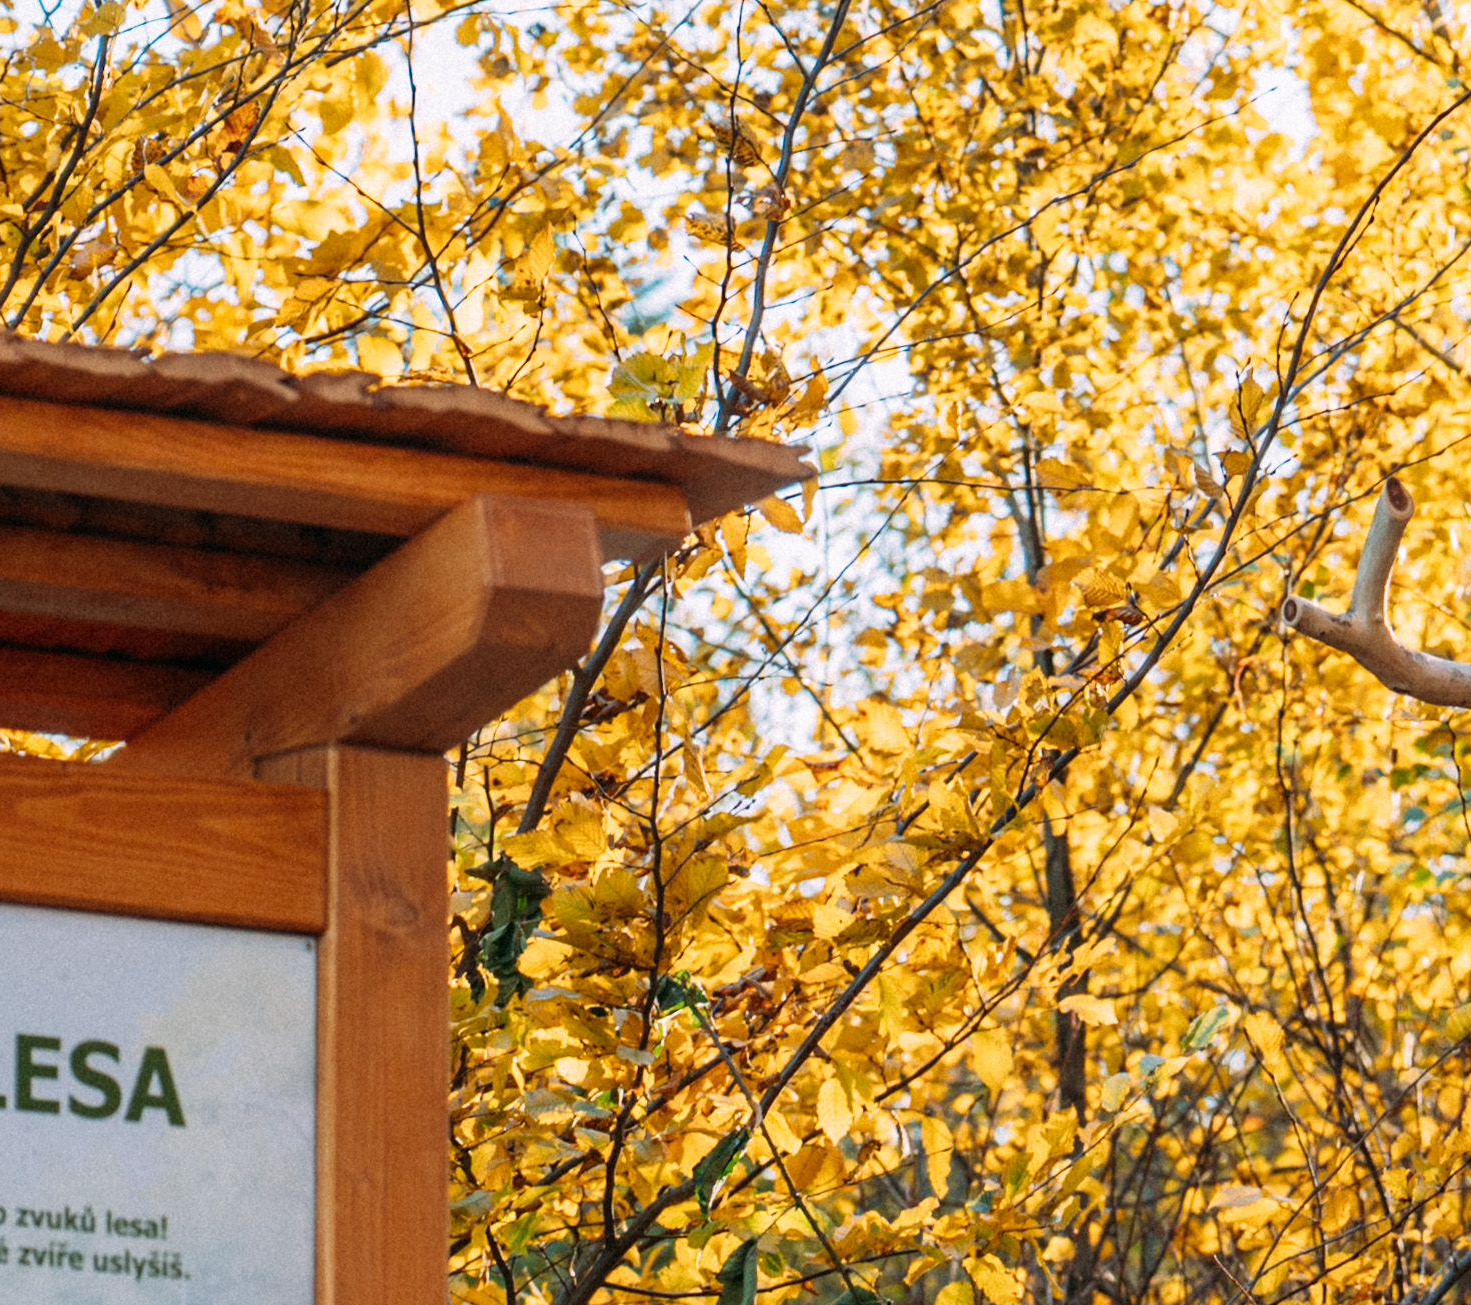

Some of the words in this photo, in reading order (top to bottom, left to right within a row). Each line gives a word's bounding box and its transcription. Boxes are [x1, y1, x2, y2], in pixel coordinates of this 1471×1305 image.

[15, 1205, 96, 1234] zvuků
[106, 1210, 169, 1240] lesa!
[17, 1240, 85, 1272] zvíře
[92, 1250, 192, 1283] uslyšíš.
